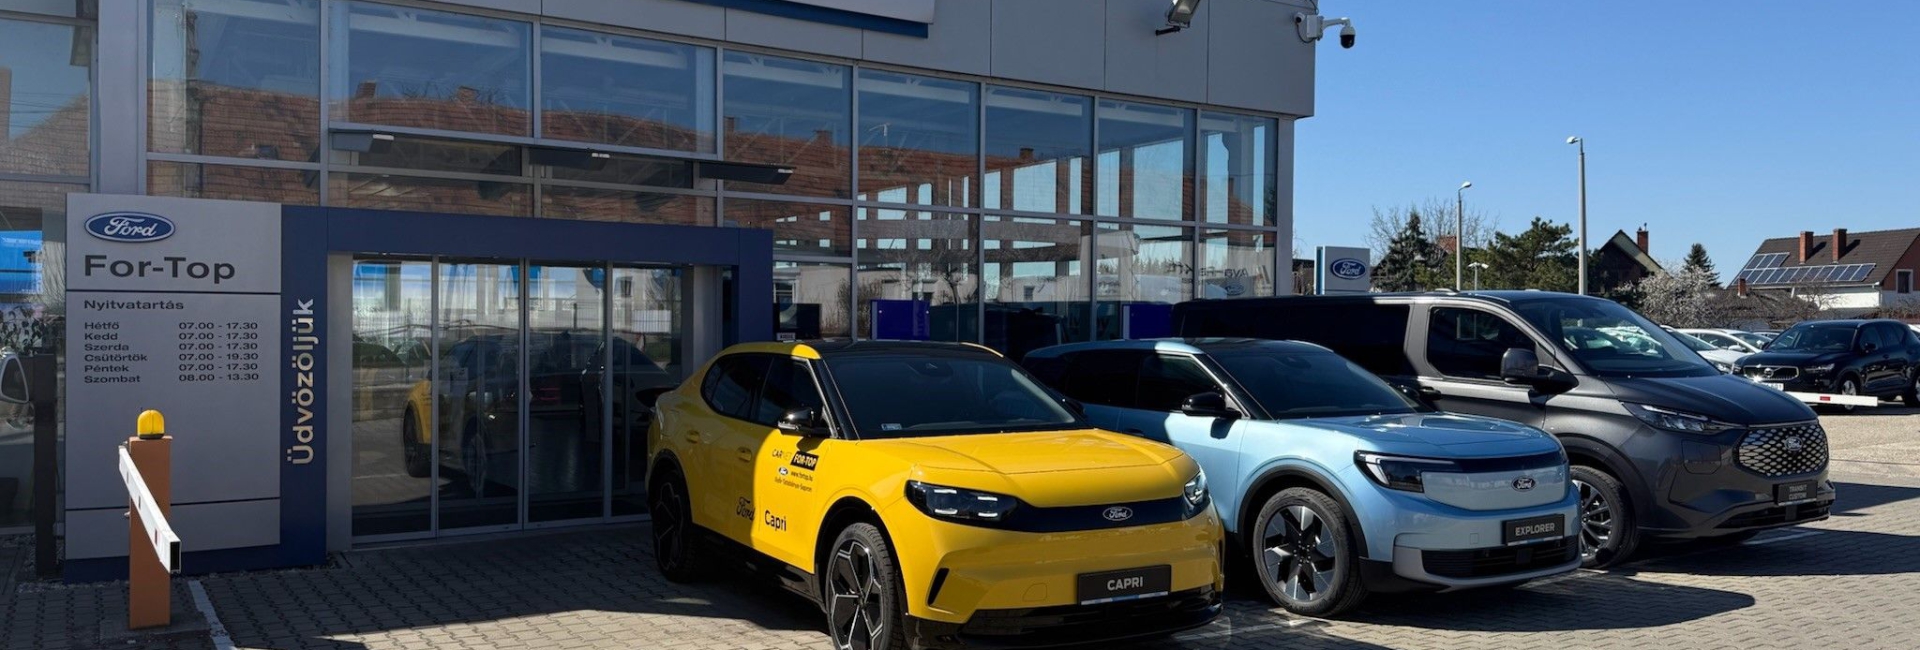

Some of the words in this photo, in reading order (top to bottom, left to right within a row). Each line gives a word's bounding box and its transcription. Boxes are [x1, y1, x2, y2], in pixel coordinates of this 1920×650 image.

[104, 216, 158, 236] Ford
[85, 254, 235, 284] For-Top
[1340, 260, 1360, 277] Ford
[84, 300, 184, 311] Nyitvatartás
[84, 332, 118, 340] Kedd
[179, 332, 214, 340] 07.00
[226, 332, 258, 340] 17.30
[84, 343, 129, 351] Szerda
[226, 342, 258, 350] 17.30
[84, 354, 148, 362] Csütörtök
[179, 353, 214, 361] 07.00
[84, 375, 141, 384] Szombat
[287, 299, 319, 464] Üdvözöljük
[793, 453, 817, 467] FOR-TOP
[736, 496, 756, 521] Ford
[1109, 506, 1128, 519] Ford
[765, 509, 787, 532] Capri
[1515, 522, 1555, 536] EXPLORER
[1107, 577, 1143, 591] CAPRI
